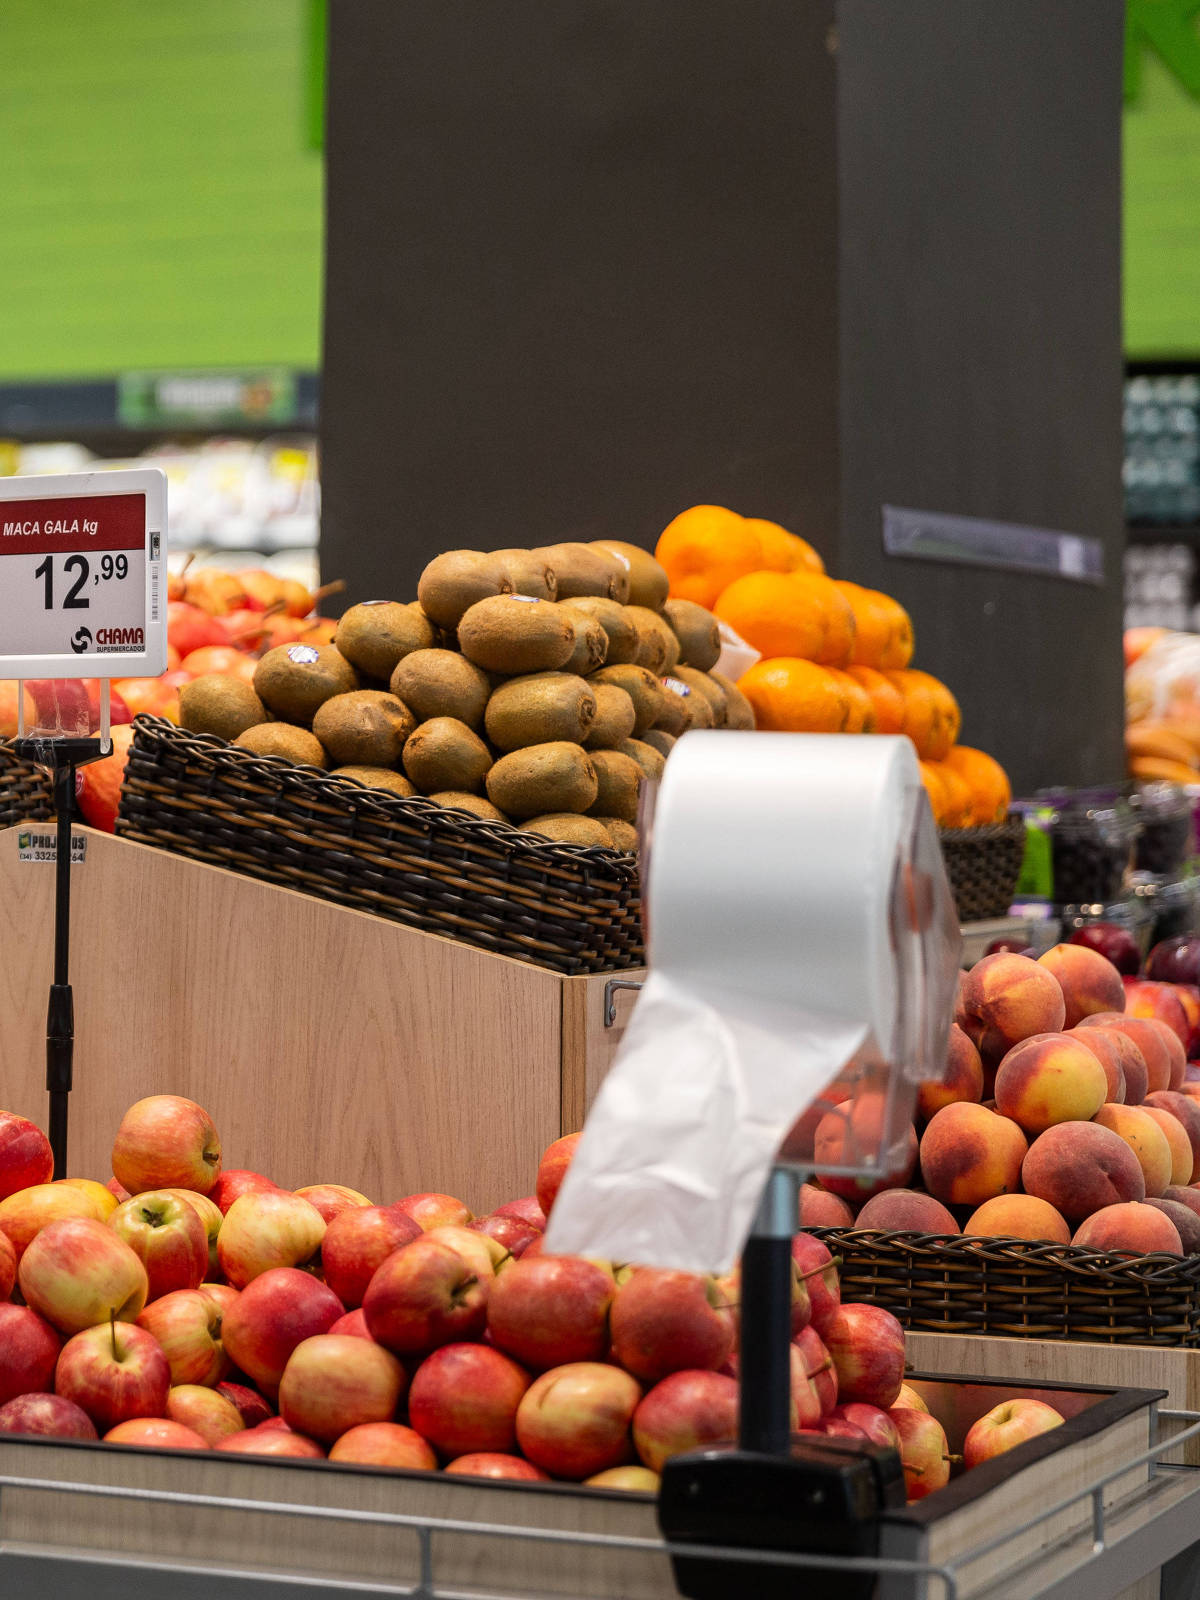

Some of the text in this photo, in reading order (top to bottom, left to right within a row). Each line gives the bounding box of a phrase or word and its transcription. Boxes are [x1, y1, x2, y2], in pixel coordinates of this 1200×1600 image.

[3, 518, 98, 536] MACA GALA kg
[96, 627, 144, 645] CHAMA
[96, 645, 146, 653] SUPERMERCADOS
[32, 835, 85, 850] PROJOS
